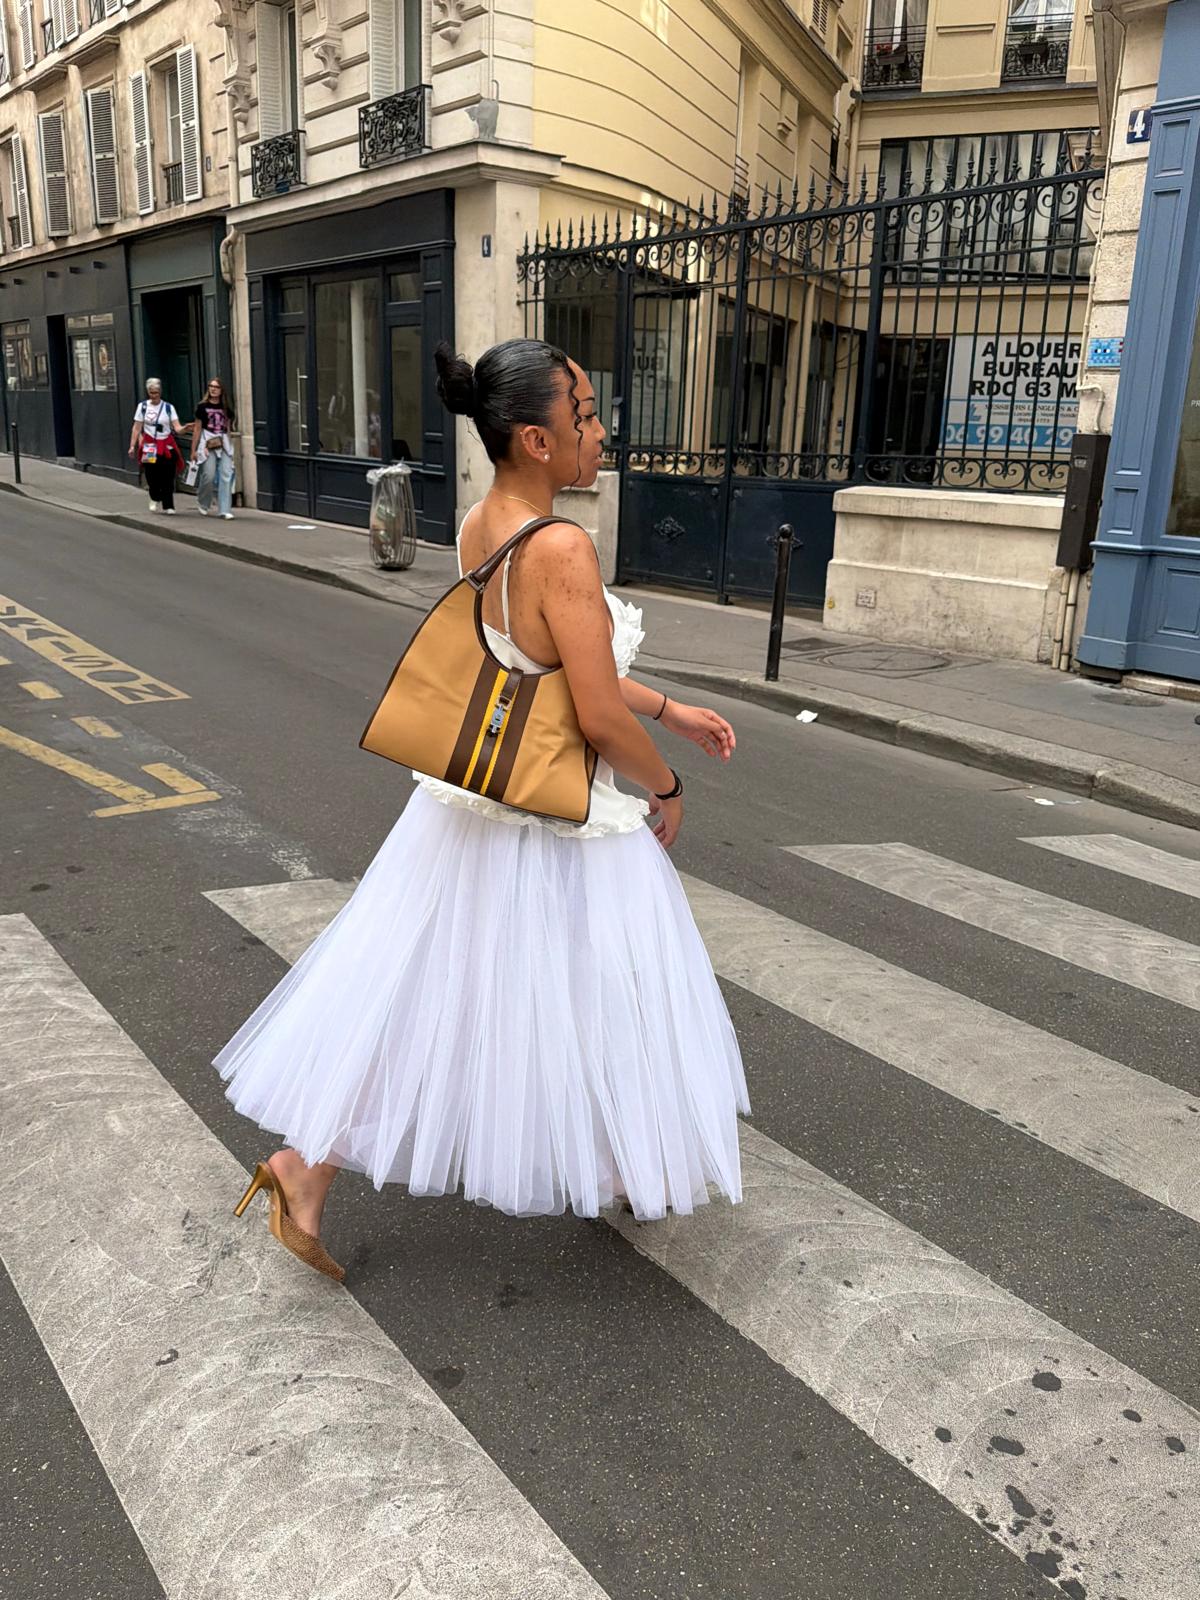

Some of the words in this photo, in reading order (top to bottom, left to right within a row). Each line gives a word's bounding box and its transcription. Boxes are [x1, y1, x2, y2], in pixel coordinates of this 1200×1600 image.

[1133, 110, 1146, 139] 4
[981, 341, 996, 357] A
[1005, 341, 1081, 359] LOUER
[983, 361, 1079, 378] BUREAU
[970, 380, 1015, 397] RDC
[1024, 381, 1051, 398] 63
[975, 425, 1004, 444] 99
[1010, 426, 1038, 445] 40
